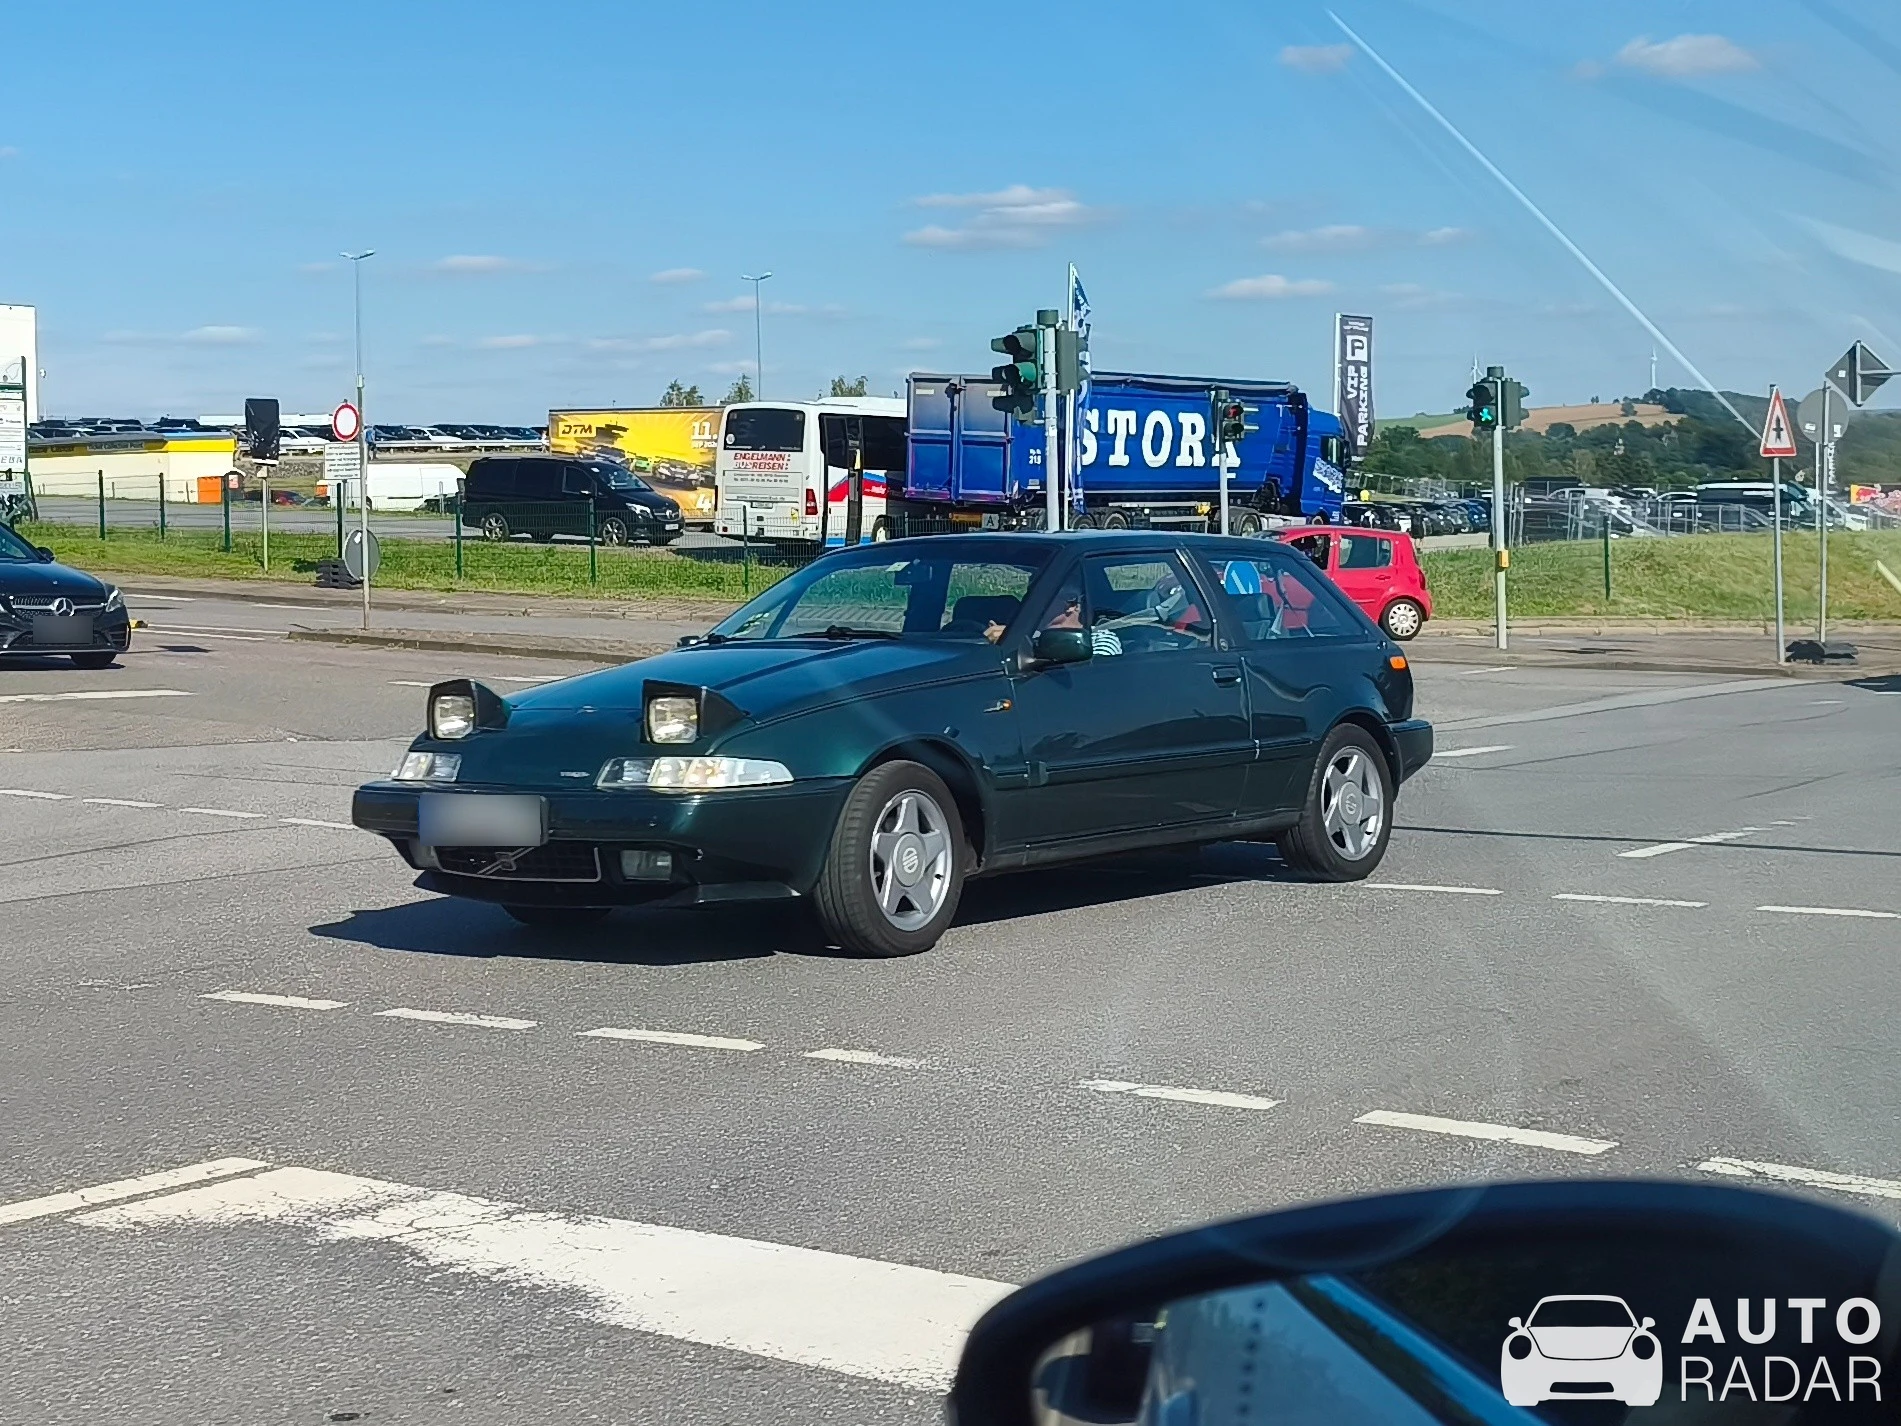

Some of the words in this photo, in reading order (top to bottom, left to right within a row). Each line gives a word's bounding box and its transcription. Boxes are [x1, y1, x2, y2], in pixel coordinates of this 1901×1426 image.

[1347, 365, 1359, 399] VIP
[1356, 366, 1368, 446] PARKING
[561, 424, 593, 435] DTM
[733, 452, 786, 461] ENGELMANN
[985, 516, 995, 527] A
